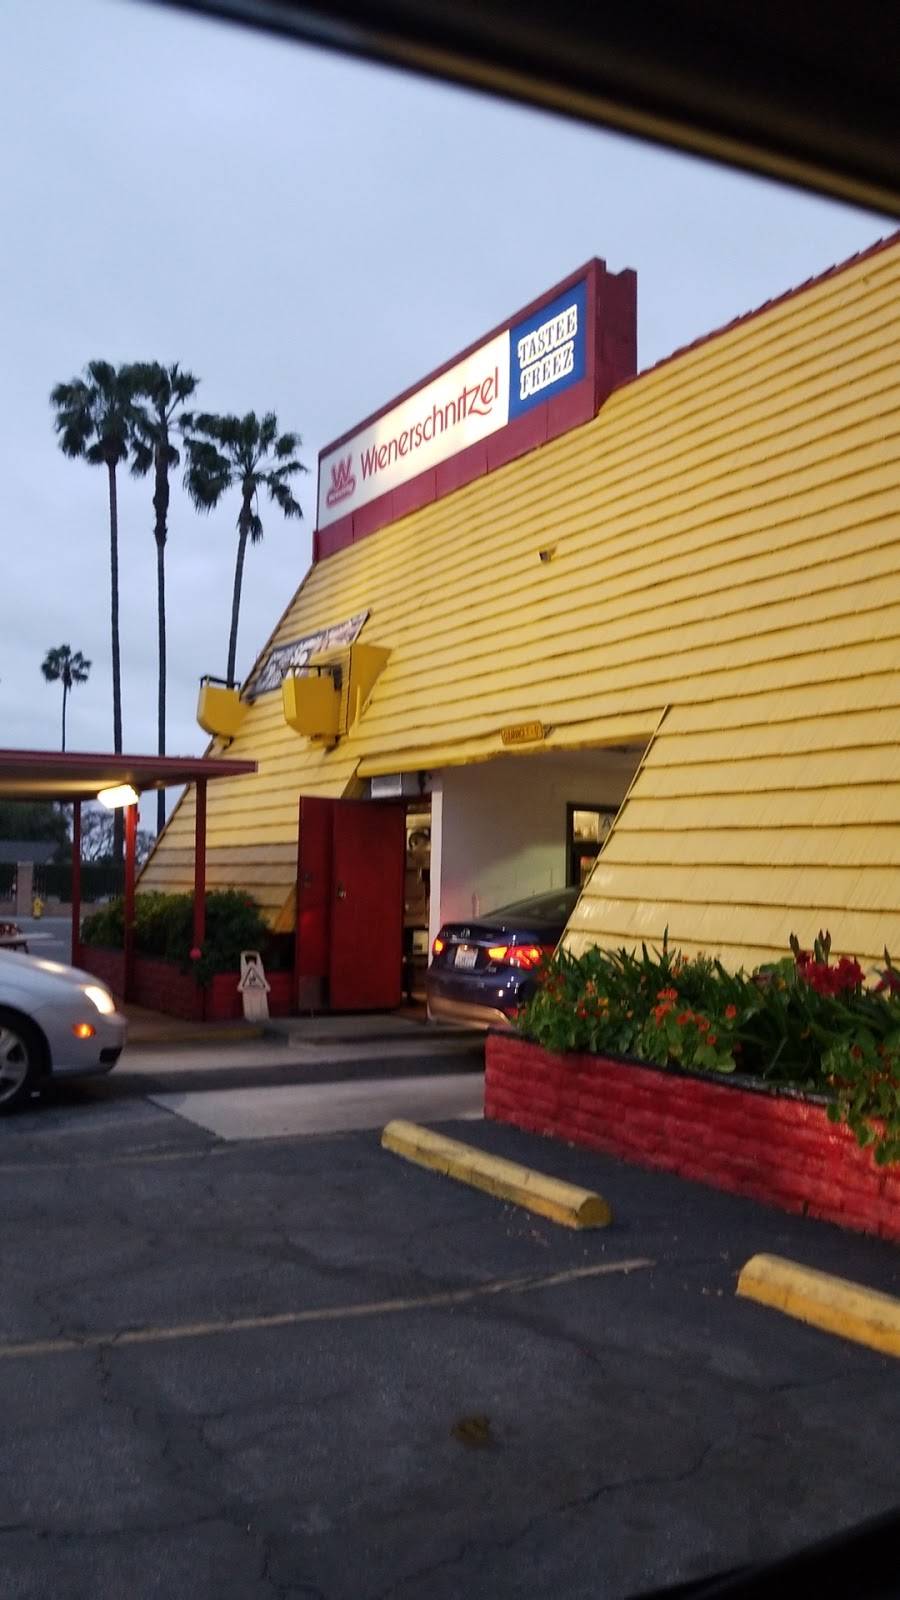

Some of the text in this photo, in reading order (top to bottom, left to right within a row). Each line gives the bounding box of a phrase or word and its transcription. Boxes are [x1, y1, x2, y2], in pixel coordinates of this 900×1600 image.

[519, 308, 577, 363] TASTEE
[520, 347, 574, 397] FREEZ
[360, 366, 499, 481] Wienerschnitzel
